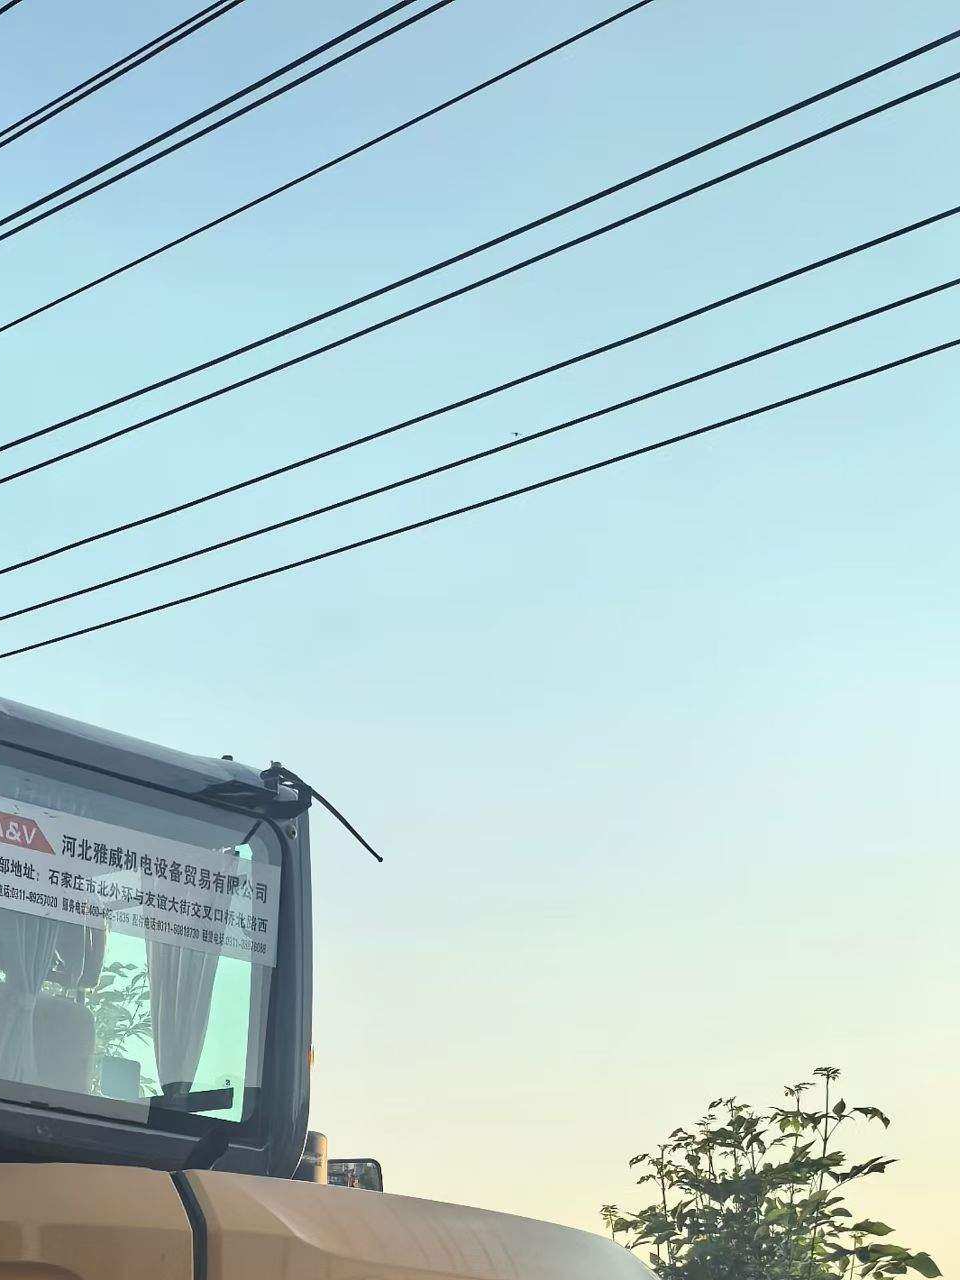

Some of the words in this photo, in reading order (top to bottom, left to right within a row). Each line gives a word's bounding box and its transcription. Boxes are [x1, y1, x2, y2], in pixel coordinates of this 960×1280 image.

[62, 834, 268, 904] 河北雅威机电设备贸易有限公司
